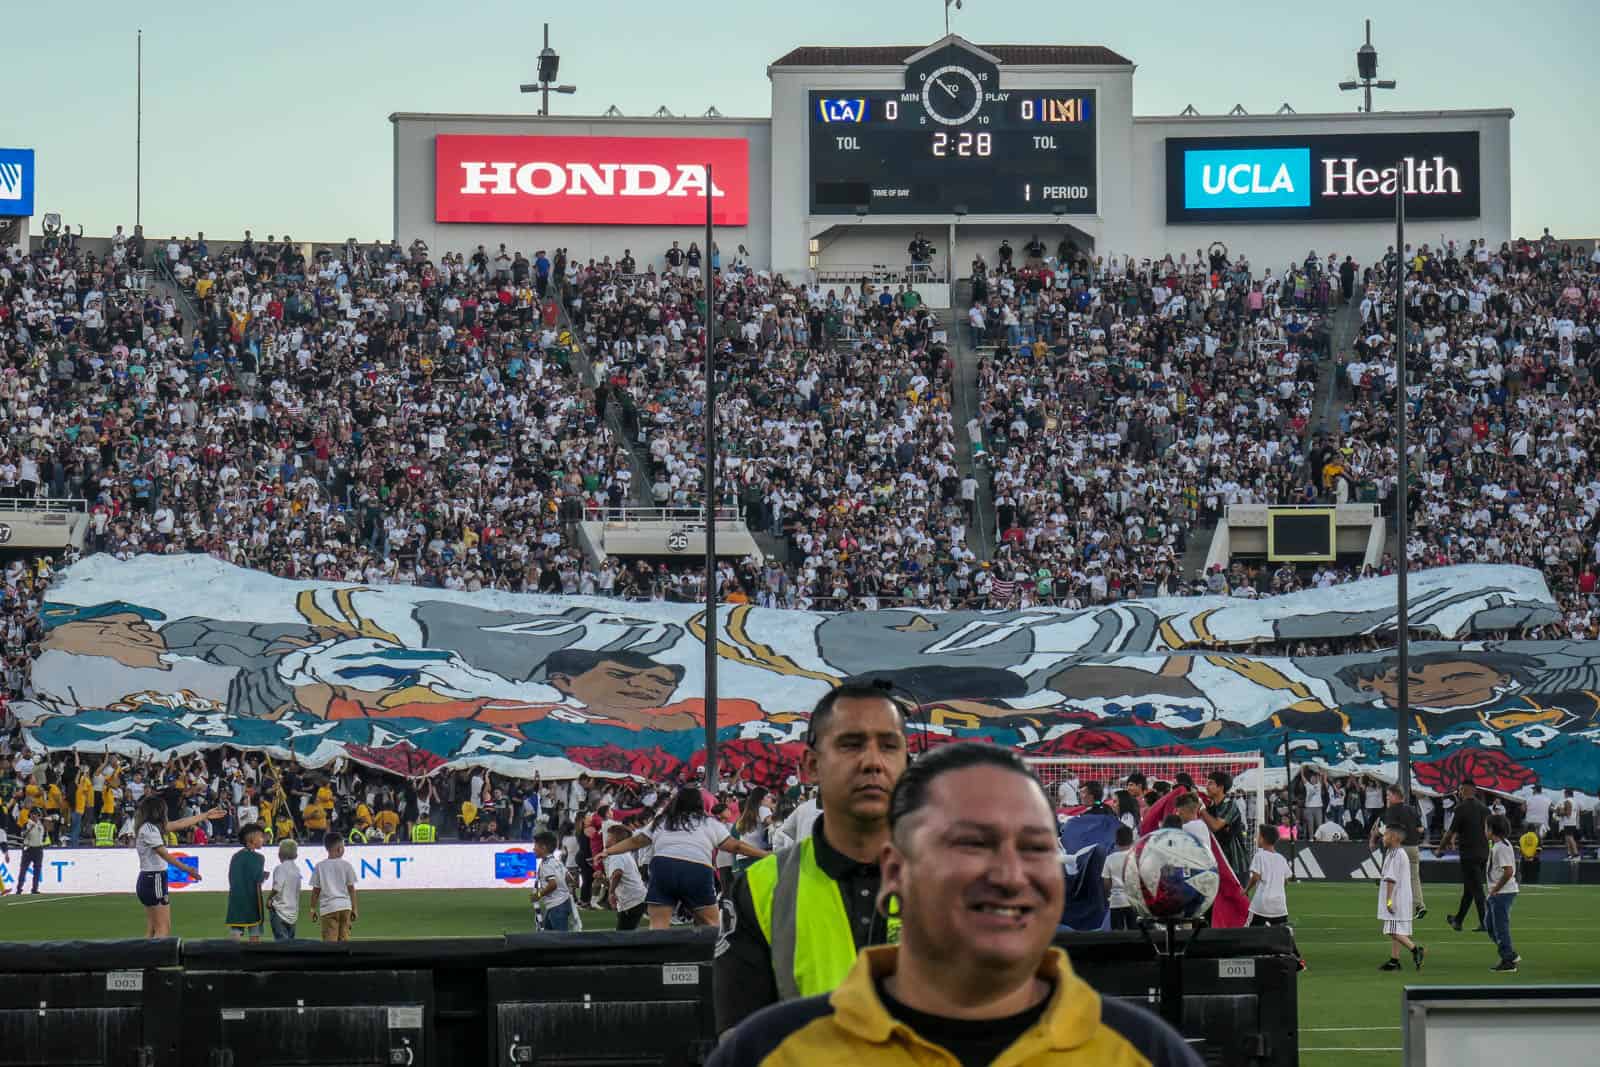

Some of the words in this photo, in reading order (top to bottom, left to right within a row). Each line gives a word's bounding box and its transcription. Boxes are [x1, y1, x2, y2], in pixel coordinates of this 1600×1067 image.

[919, 73, 926, 81] 0
[977, 73, 988, 81] 15
[901, 93, 919, 102] MIN
[985, 93, 1010, 102] PLAY
[830, 105, 855, 121] LA
[886, 100, 898, 121] 0
[1021, 100, 1033, 120] 0
[978, 116, 990, 125] 10
[836, 136, 861, 150] TOL
[932, 132, 992, 157] 2:28
[1032, 135, 1057, 149] TOL
[459, 161, 725, 197] HONDA
[1202, 162, 1295, 195] UCLA
[1321, 156, 1461, 197] Health
[872, 189, 888, 197] TIME
[888, 189, 897, 197] OF
[1025, 183, 1031, 201] 1
[1043, 186, 1089, 199] PERIOD
[670, 535, 688, 548] 26
[1227, 966, 1248, 975] 001
[114, 979, 137, 988] 003
